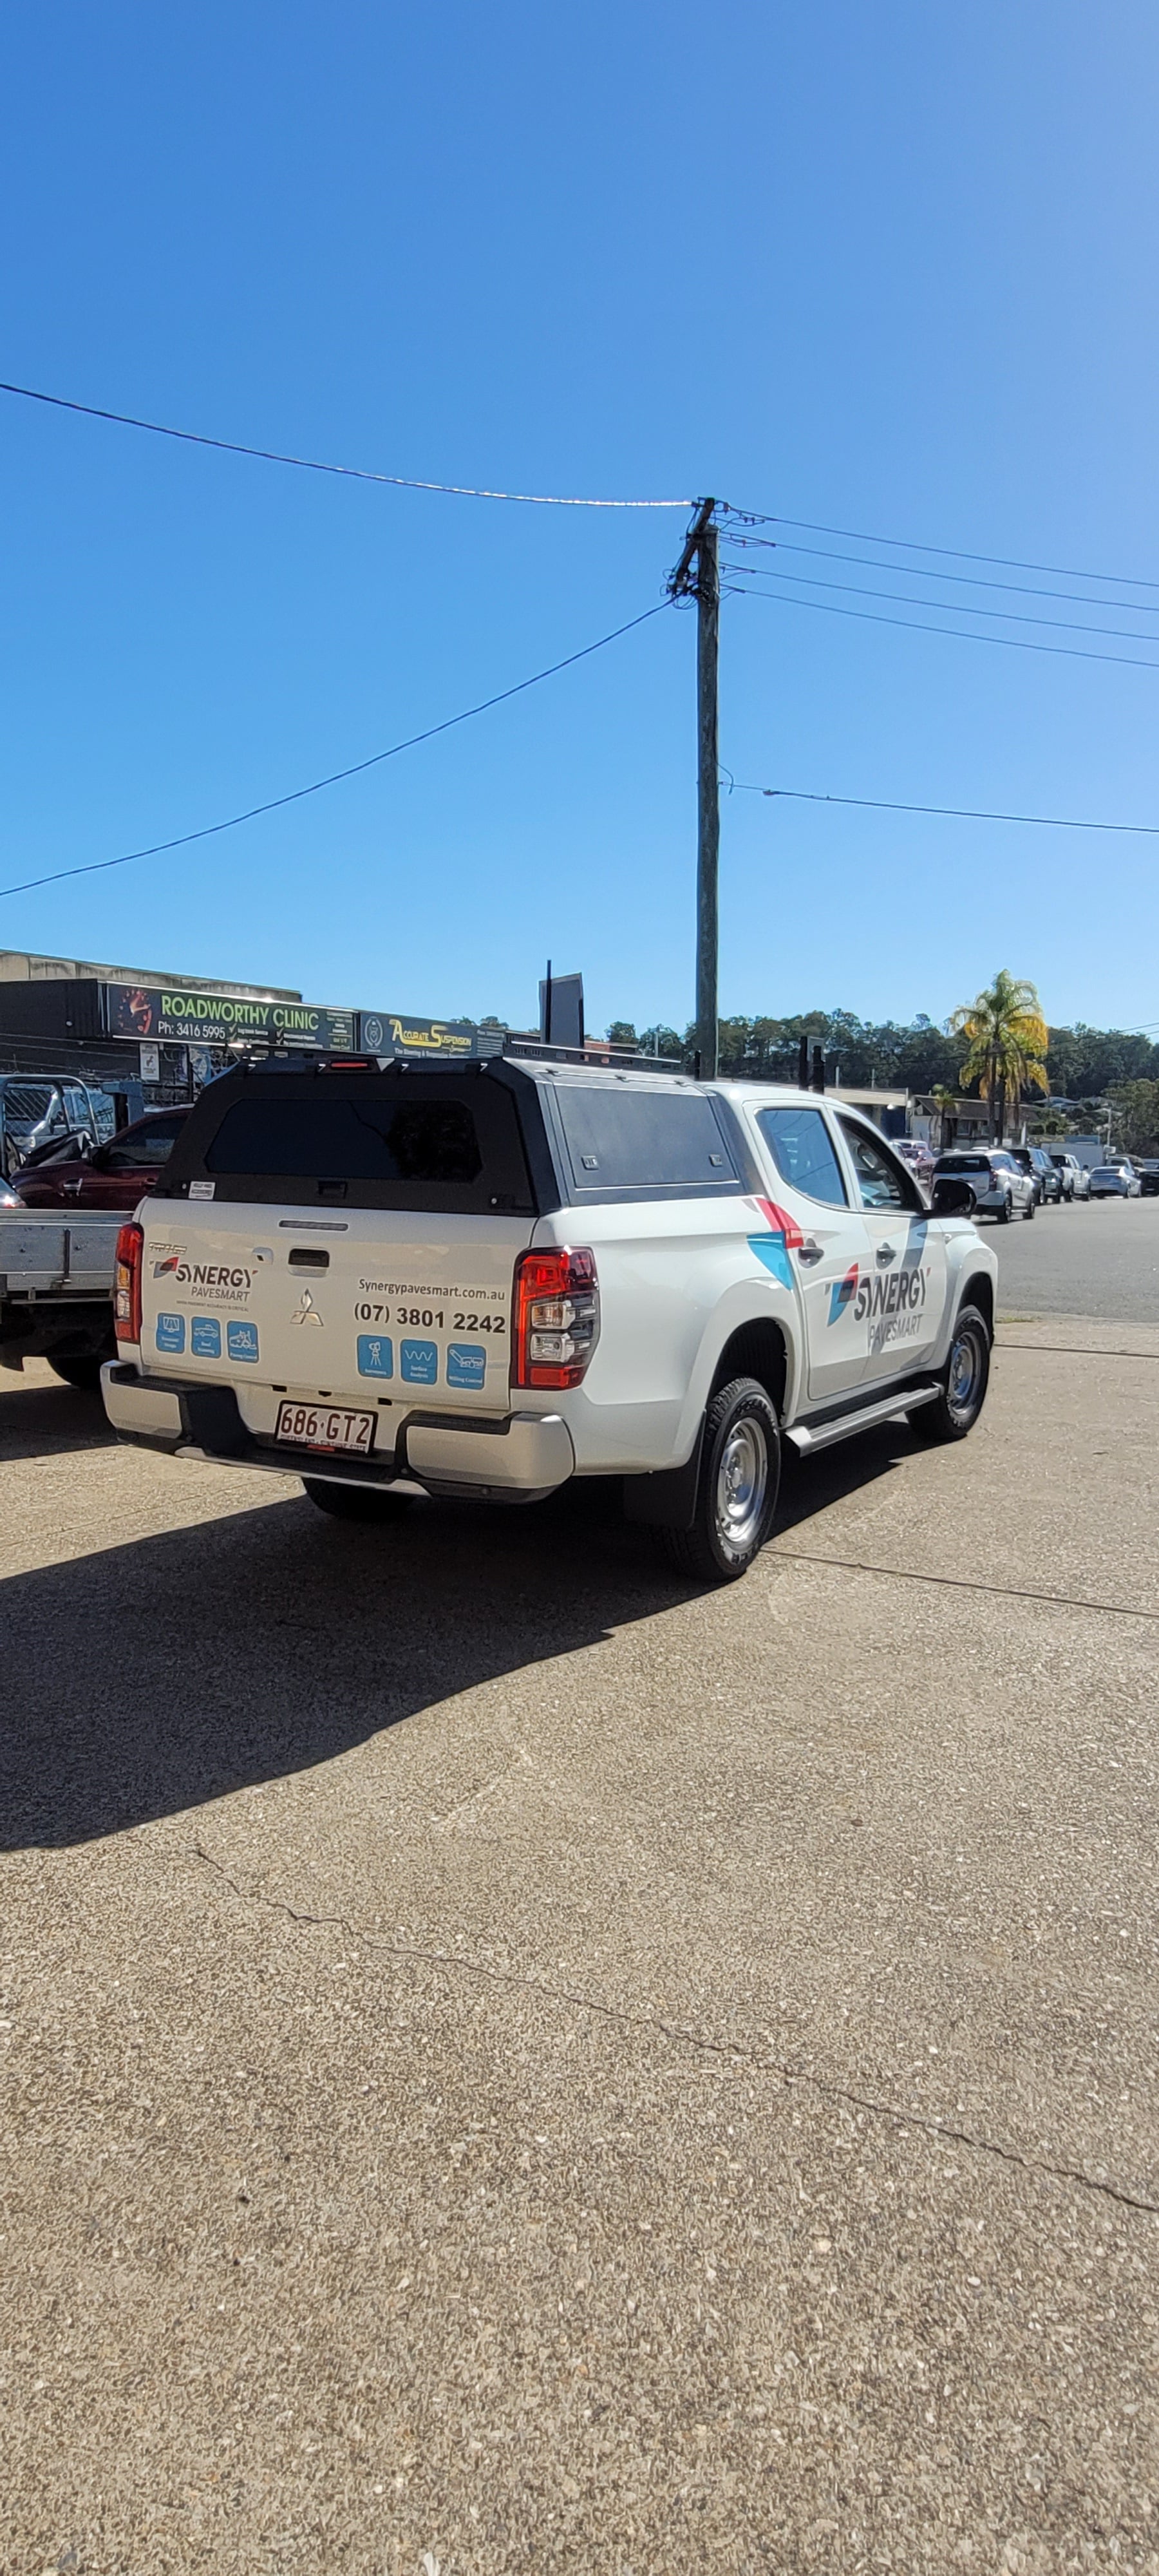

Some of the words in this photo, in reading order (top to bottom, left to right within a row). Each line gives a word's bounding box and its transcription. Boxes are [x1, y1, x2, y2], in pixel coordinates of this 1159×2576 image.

[161, 995, 269, 1025] ROADWORTHY
[272, 1009, 319, 1030] CLINIC
[158, 1021, 174, 1035] Ph:
[176, 1022, 200, 1037] 3416
[202, 1025, 226, 1039] 5995
[175, 1263, 258, 1289] SYNERGY
[359, 1278, 505, 1301] Synergypavesmart.com.au
[191, 1287, 250, 1303] PAVESMART
[853, 1267, 931, 1321] SYNERGY
[354, 1302, 390, 1324] (07)
[396, 1307, 444, 1329] 3801
[453, 1312, 506, 1334] 2242
[869, 1314, 923, 1348] PAVESMART
